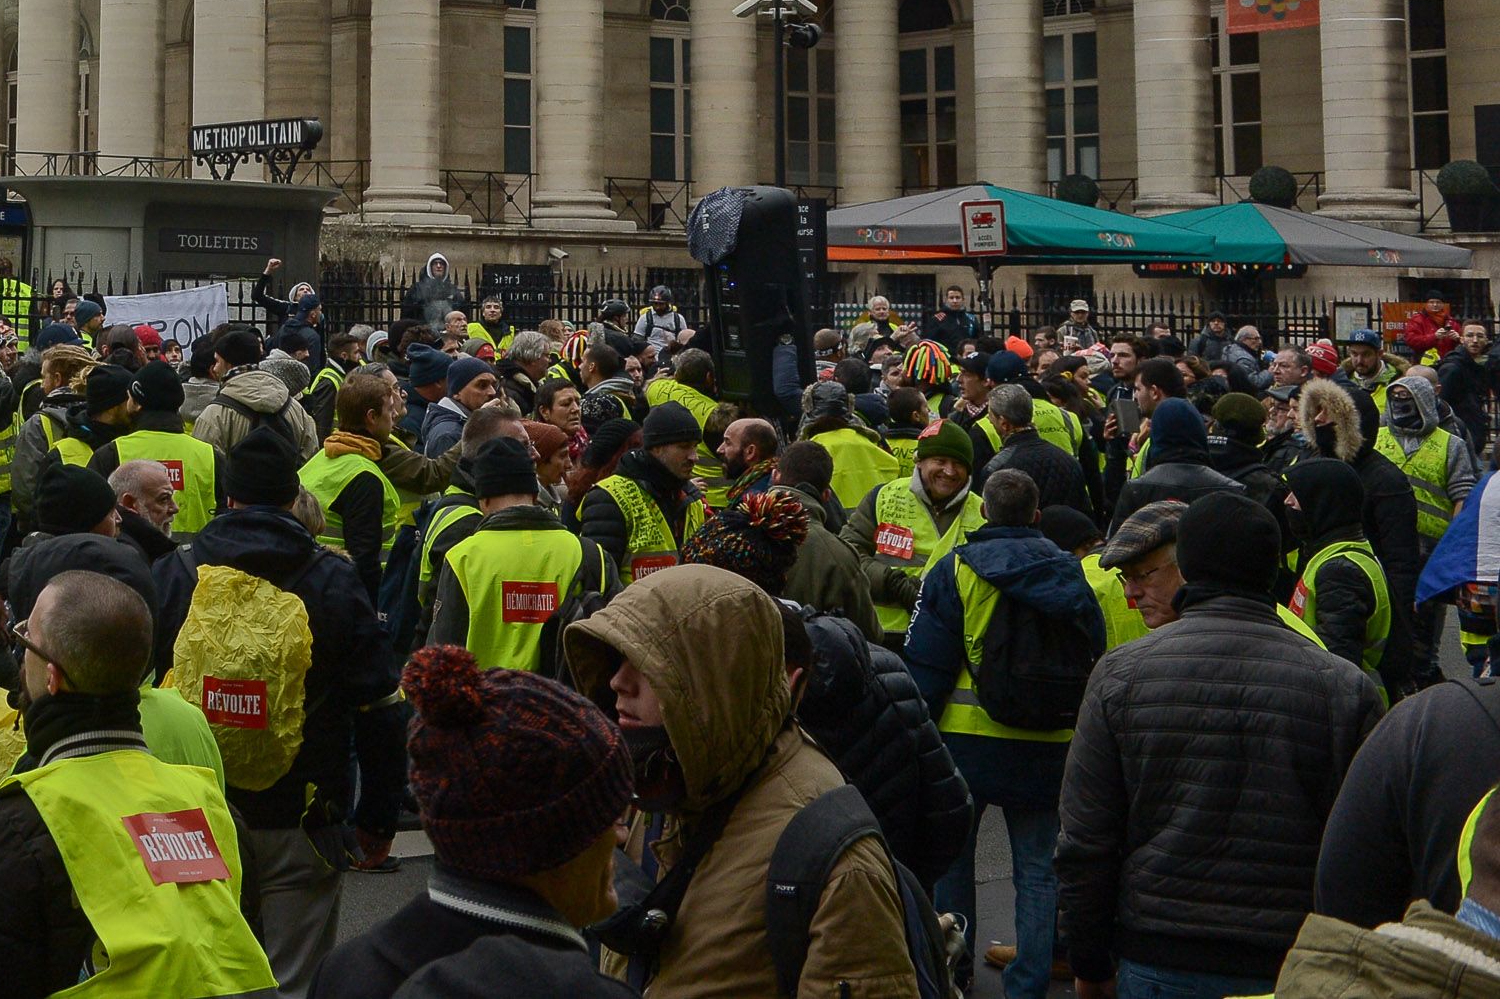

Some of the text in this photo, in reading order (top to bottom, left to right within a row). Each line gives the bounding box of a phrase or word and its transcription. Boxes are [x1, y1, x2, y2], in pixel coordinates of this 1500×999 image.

[193, 121, 301, 151] METROPOLITAIN
[178, 234, 258, 250] TOILETTES
[877, 530, 913, 551] RÉVOLTE
[506, 590, 554, 611] DÉMOCRATIE
[207, 688, 261, 715] RÉVOLTE
[139, 826, 214, 862] RÉVOLTE
